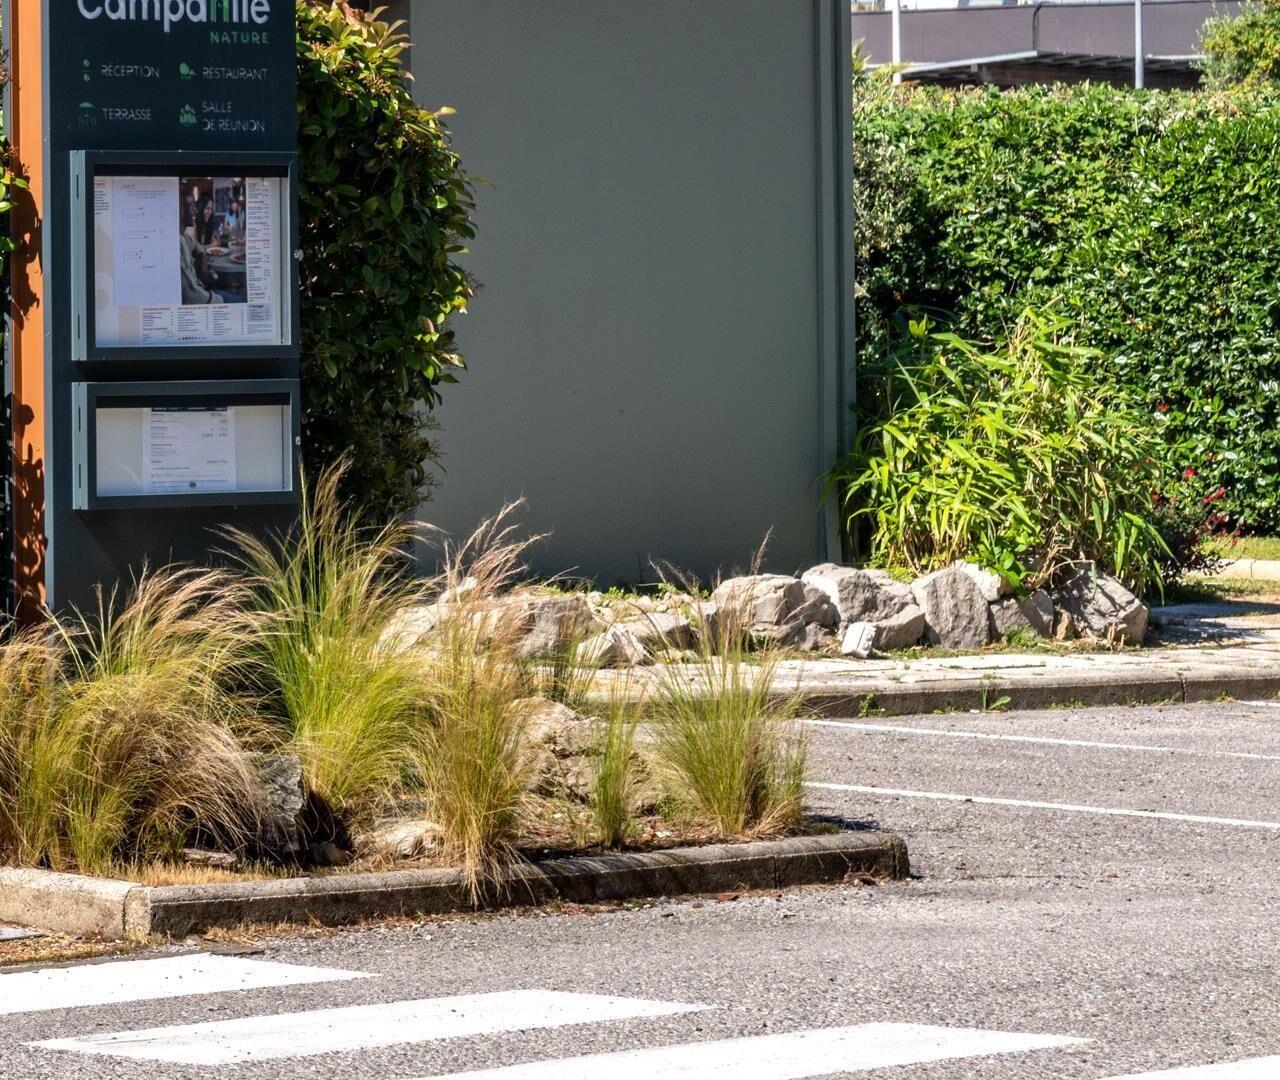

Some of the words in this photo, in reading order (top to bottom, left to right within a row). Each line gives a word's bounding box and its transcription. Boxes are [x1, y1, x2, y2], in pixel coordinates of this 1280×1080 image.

[210, 31, 271, 44] NATURE
[101, 63, 160, 78] RÉCEPTION
[202, 67, 269, 80] RESTAURANT
[202, 101, 233, 113] SALLE
[102, 108, 153, 120] TERRASSE
[203, 119, 215, 130] DE
[218, 117, 265, 131] RÉUNION
